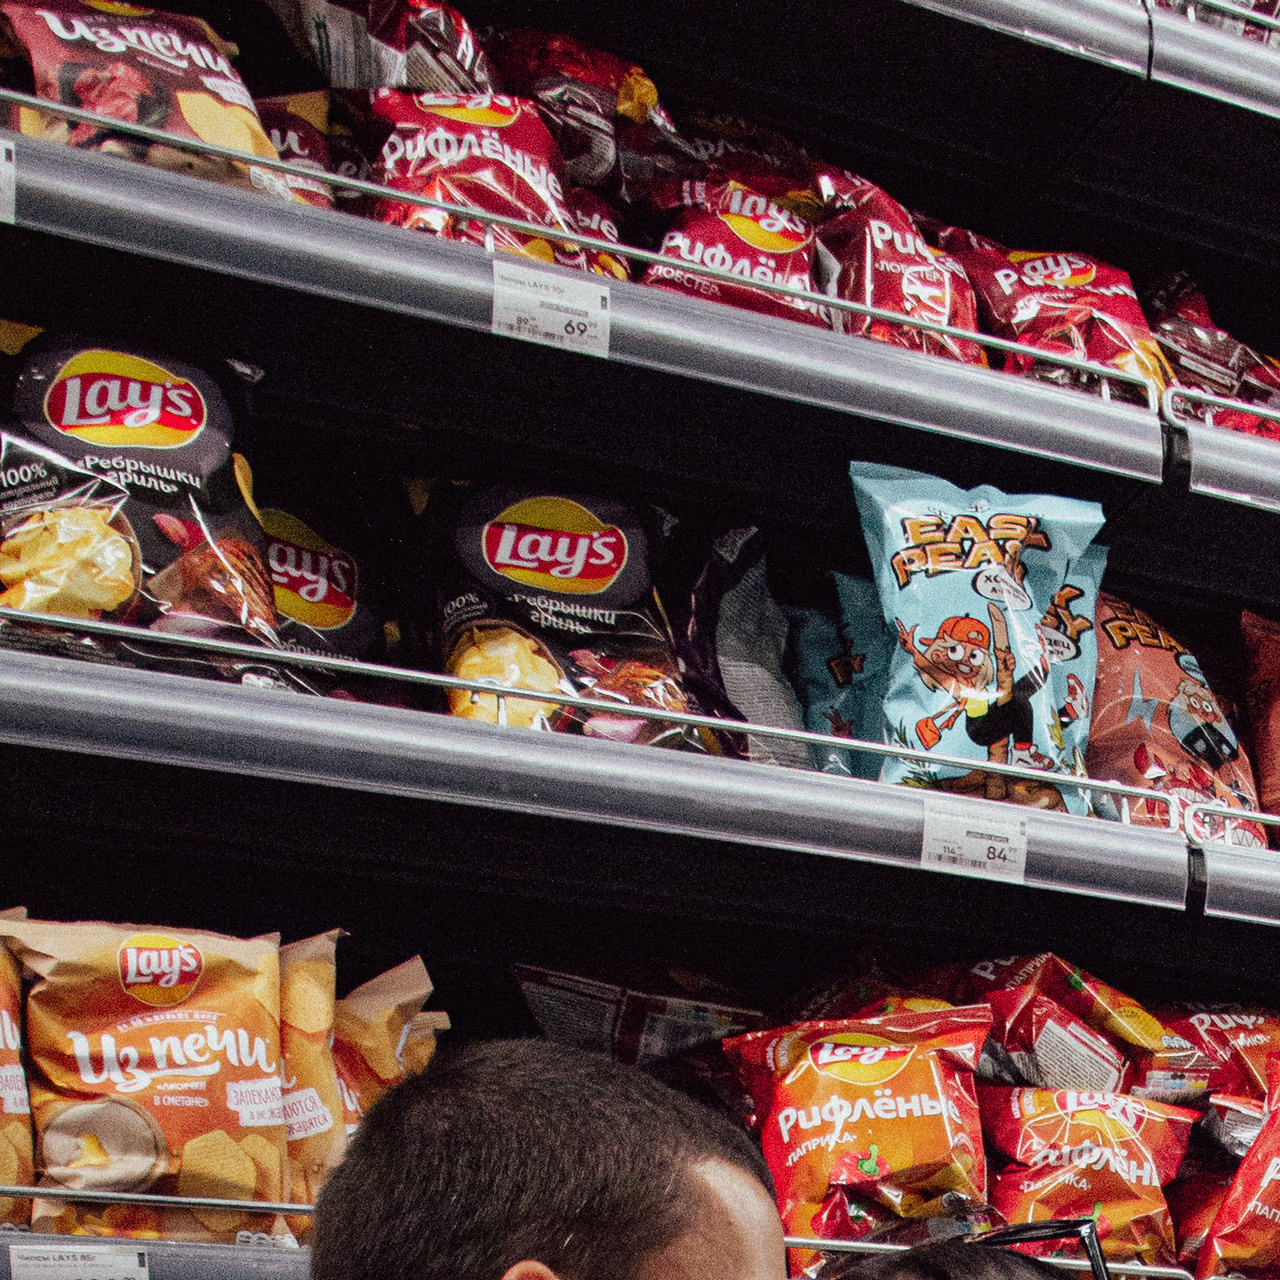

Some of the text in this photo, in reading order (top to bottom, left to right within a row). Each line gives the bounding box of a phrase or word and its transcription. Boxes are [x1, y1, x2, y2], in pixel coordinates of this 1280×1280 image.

[564, 319, 588, 337] 69
[61, 376, 196, 429] Lay's
[494, 523, 617, 579] Lay's
[986, 845, 1008, 862] 84
[126, 946, 199, 987] Lay's
[232, 1085, 282, 1106] ЗАПЕКАЮ
[778, 1089, 963, 1145] Рифлёные
[53, 1254, 78, 1262] LAYS
